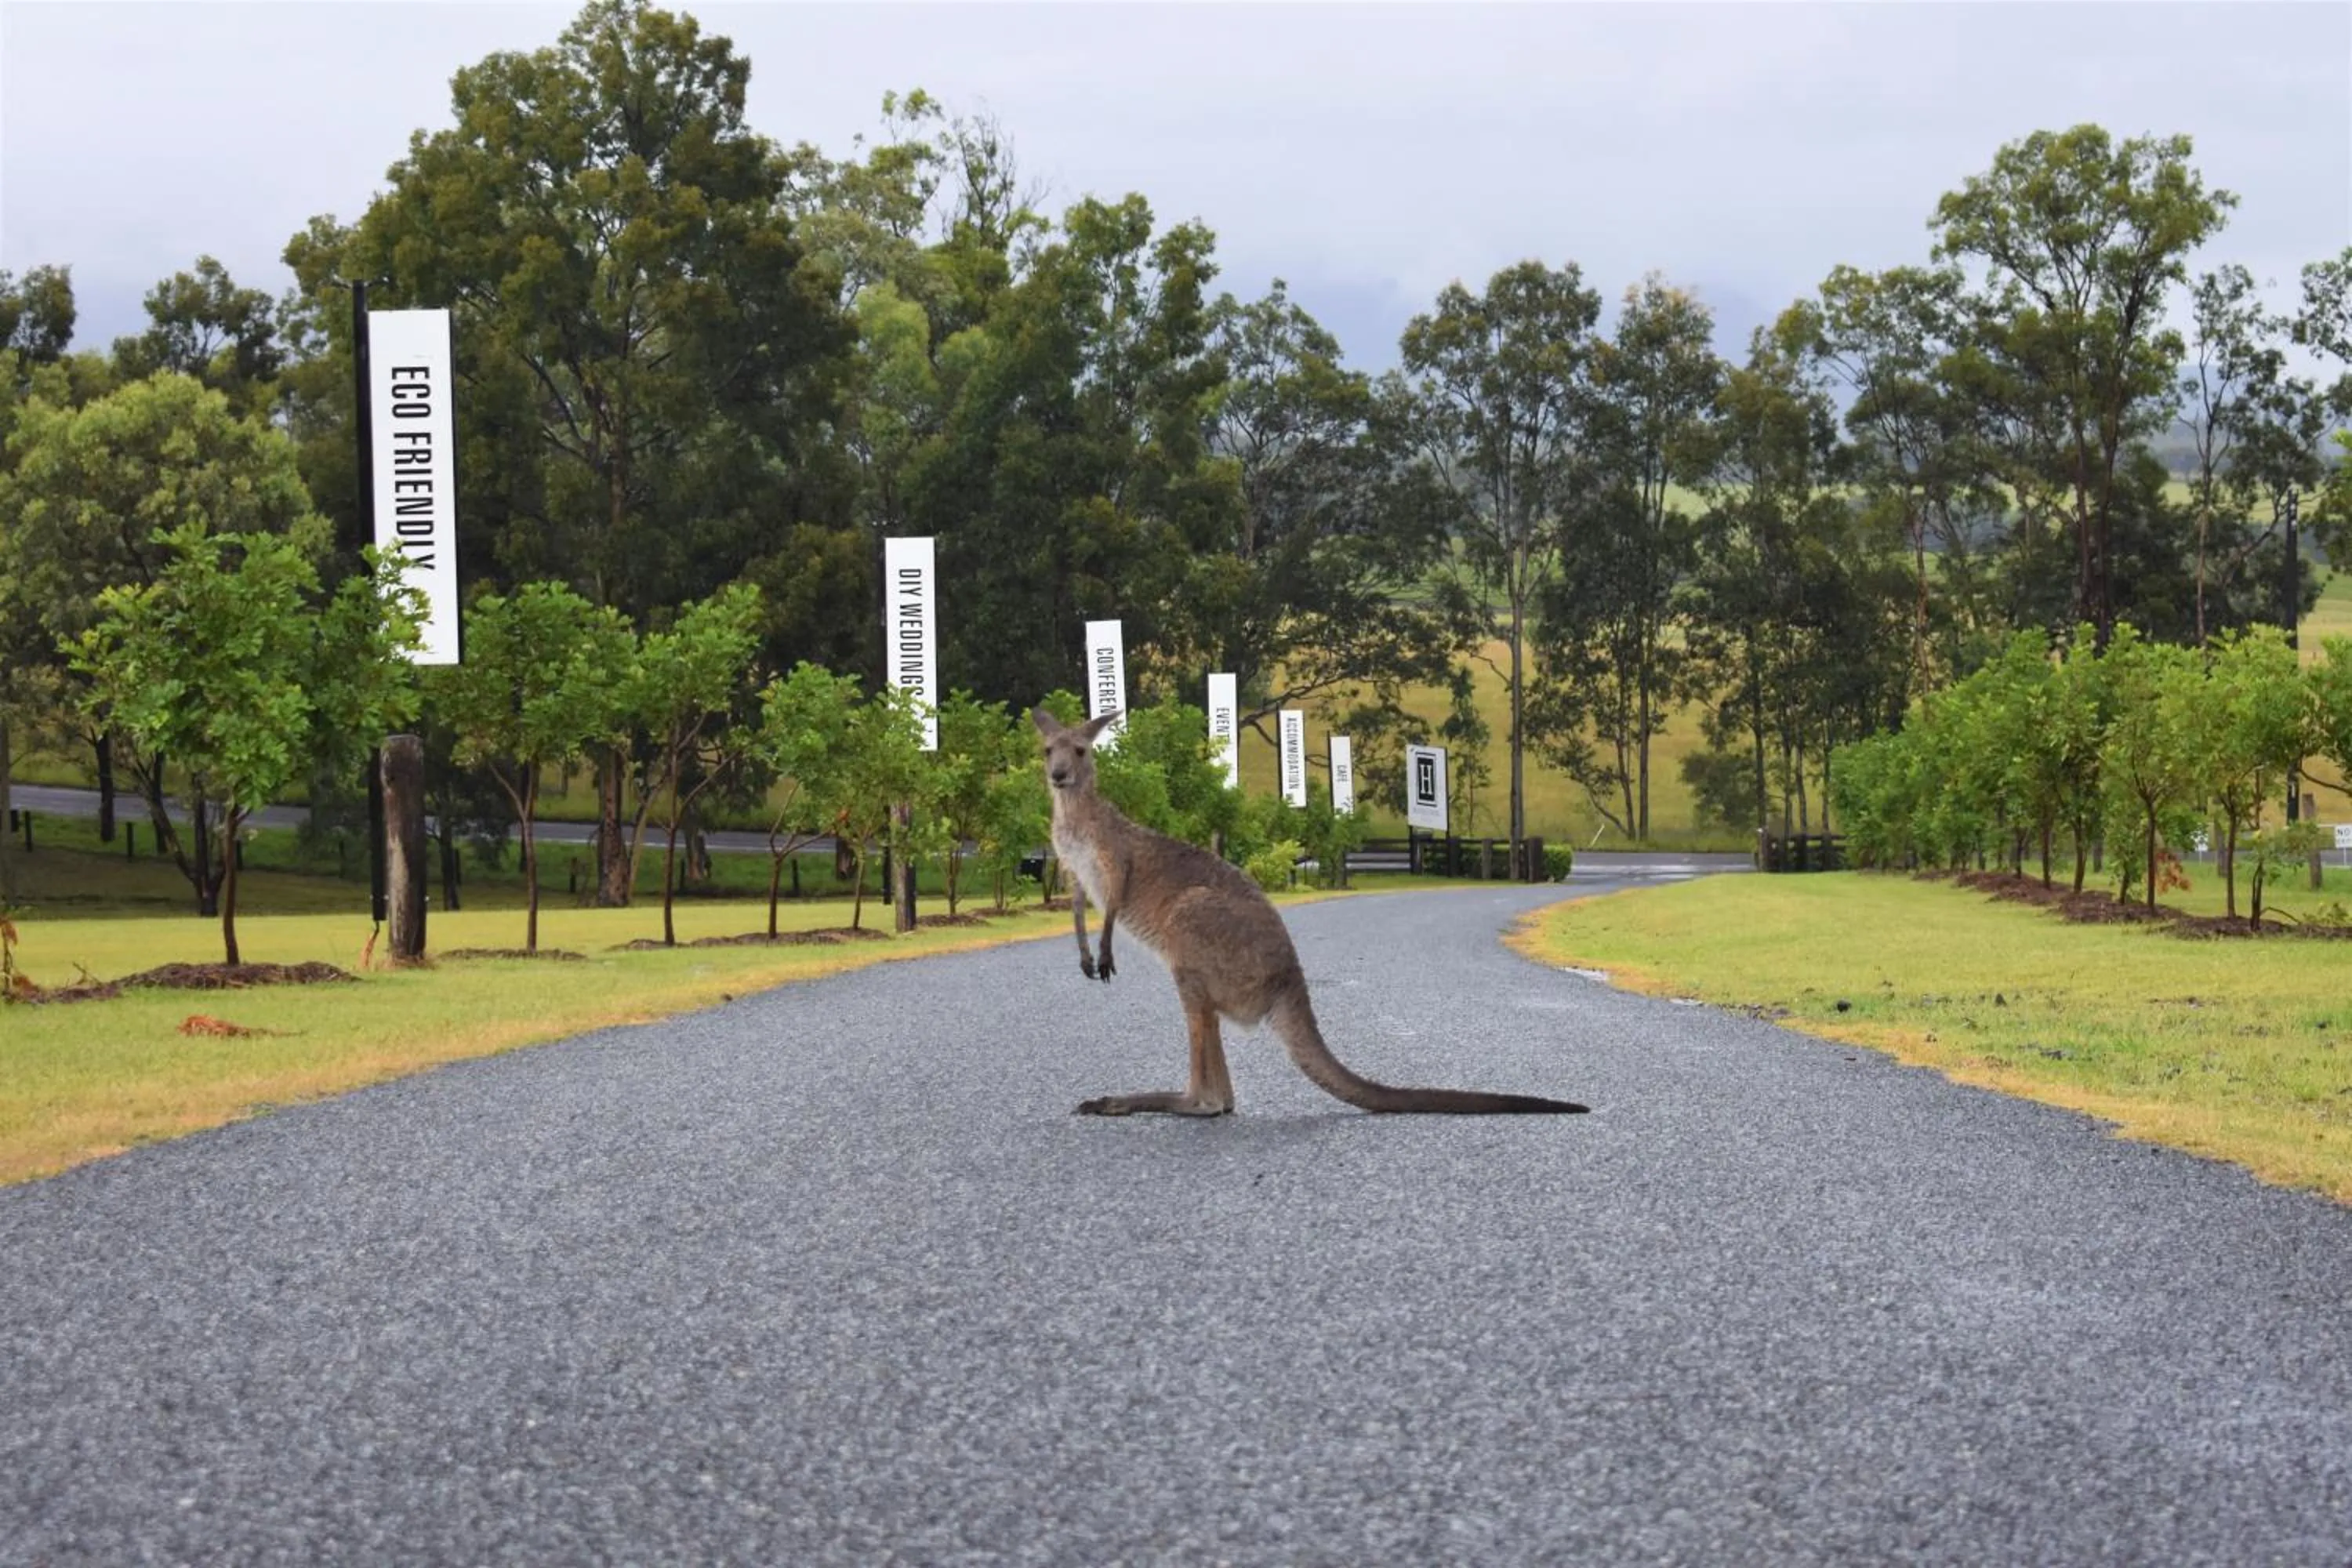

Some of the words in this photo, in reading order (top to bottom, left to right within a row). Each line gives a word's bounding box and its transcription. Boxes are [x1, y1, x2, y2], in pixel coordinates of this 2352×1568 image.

[391, 366, 431, 418] ECO
[394, 432, 435, 570] FRIENDLY
[898, 568, 922, 597] DIY
[1096, 647, 1117, 714] CONFEREN
[1216, 707, 1230, 739] EVENT
[1287, 717, 1300, 789] ACCOMMODATION
[1420, 764, 1432, 795] H
